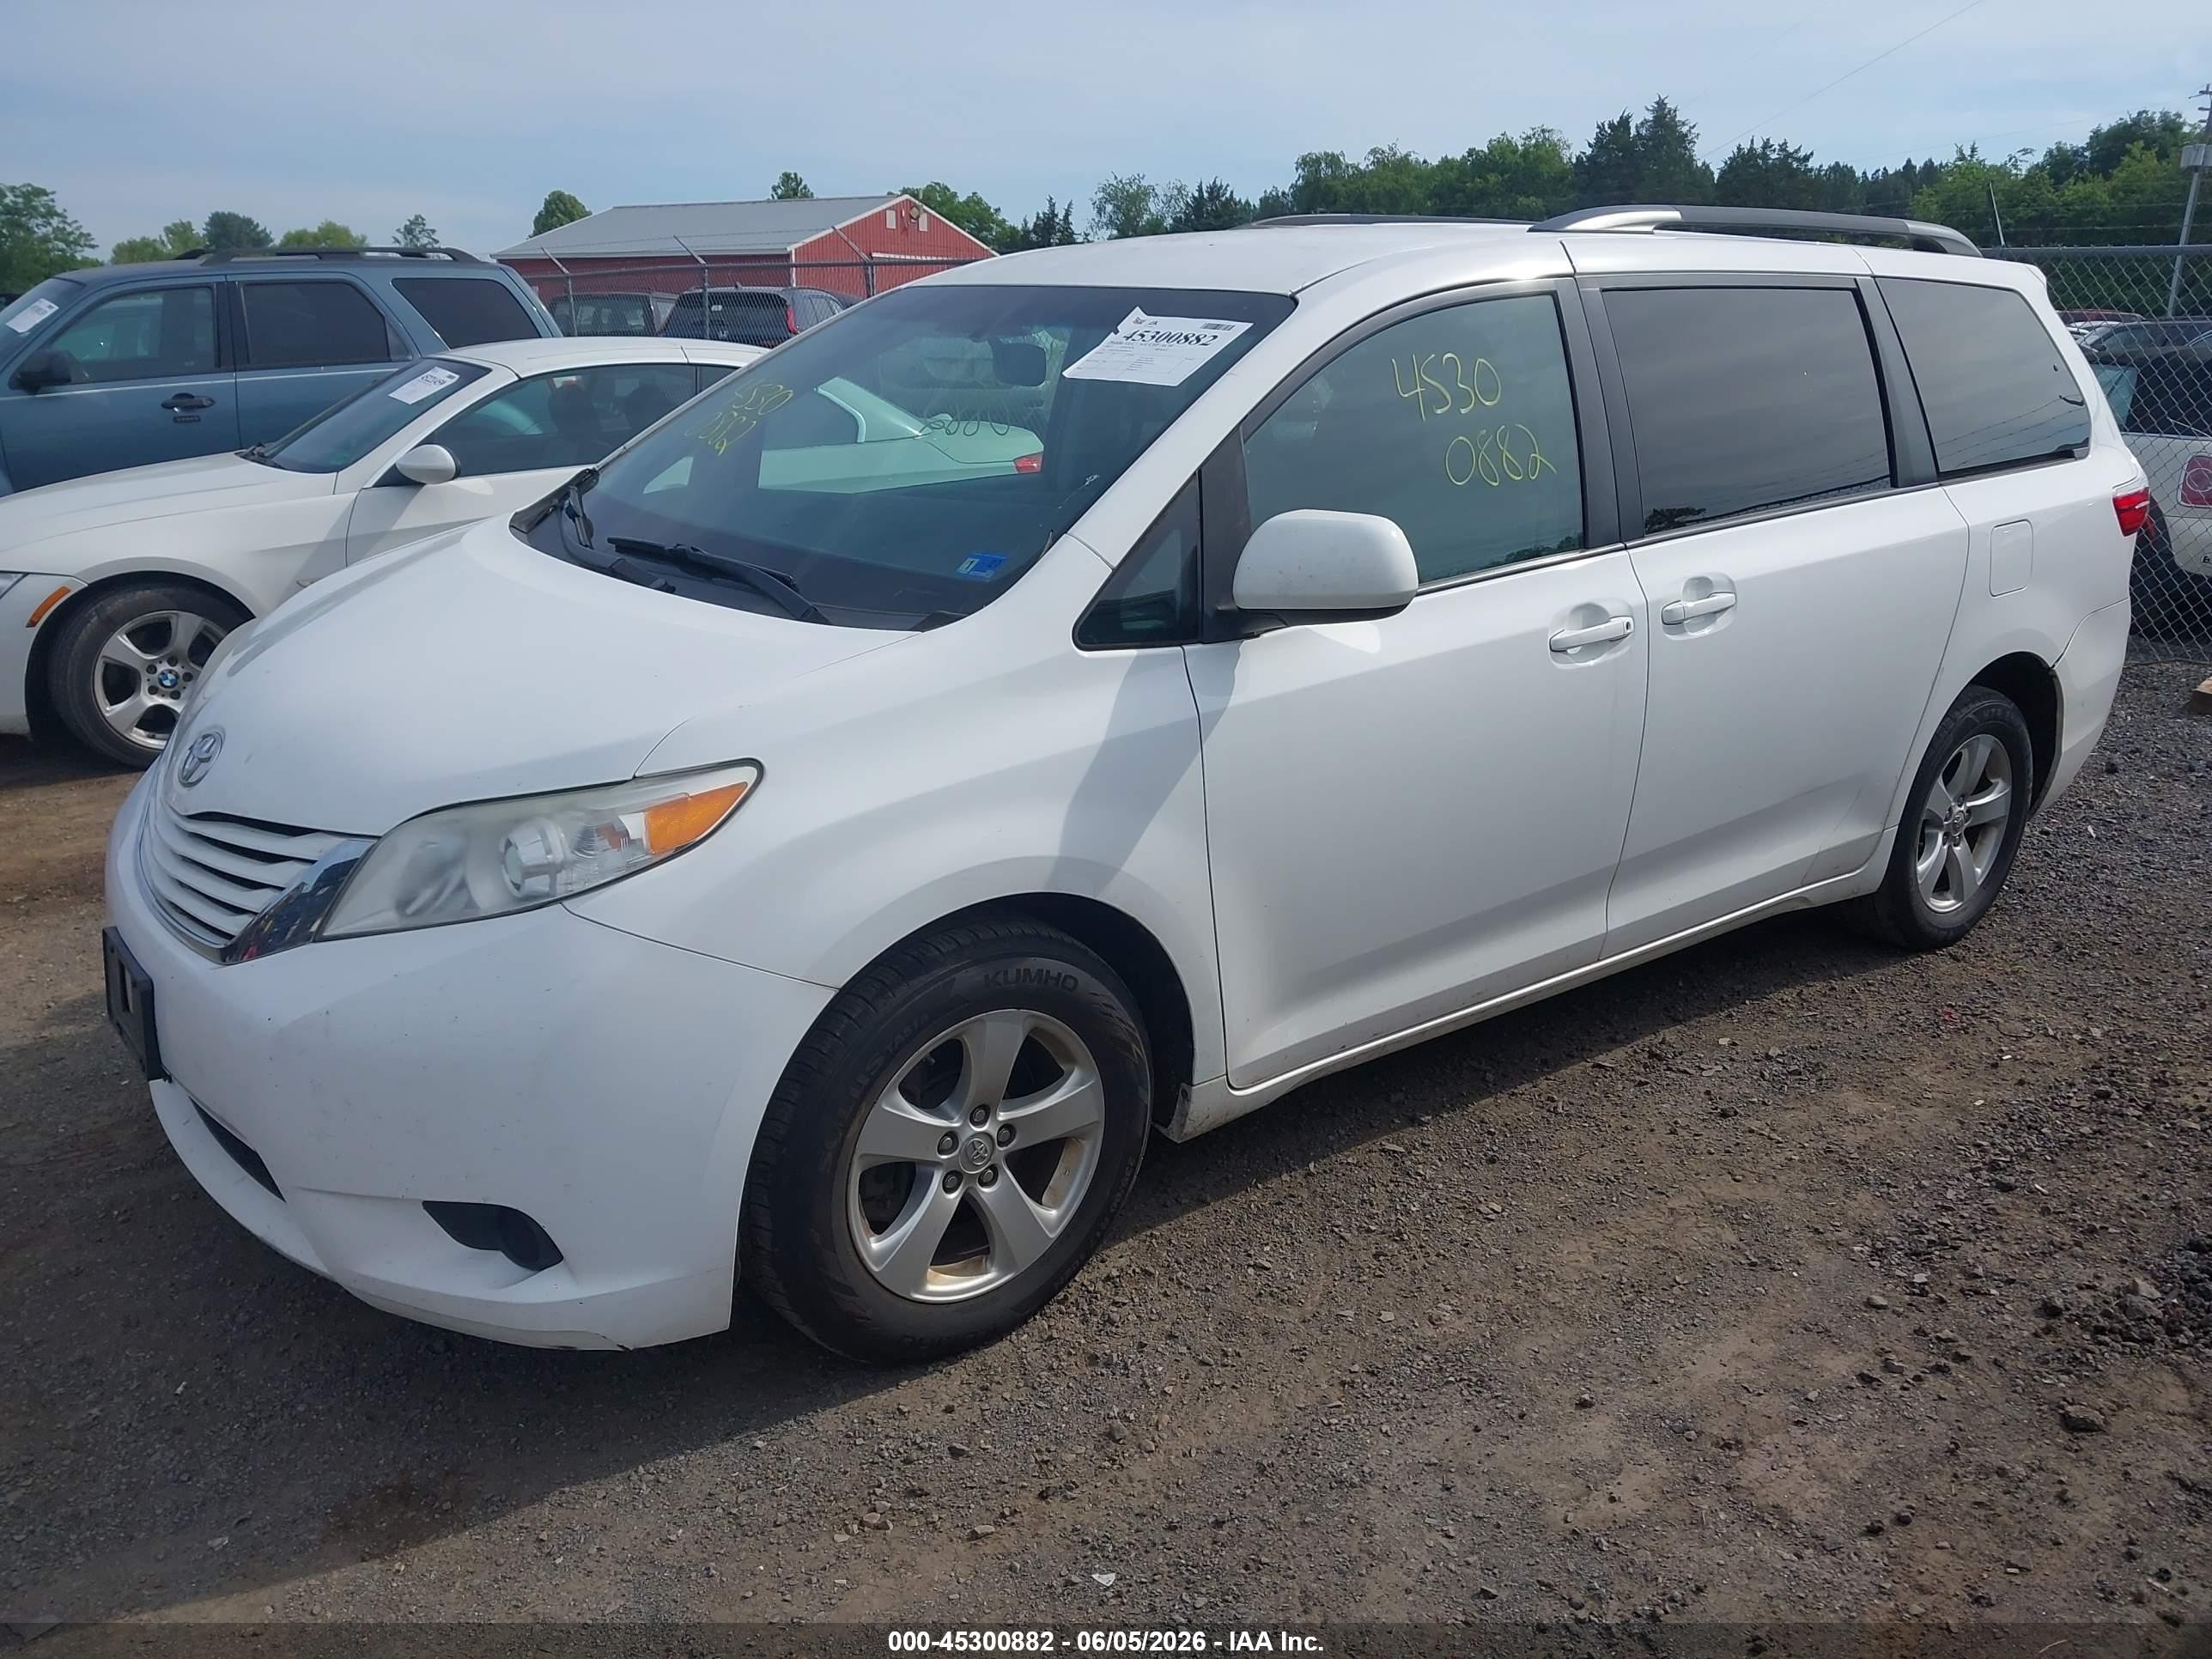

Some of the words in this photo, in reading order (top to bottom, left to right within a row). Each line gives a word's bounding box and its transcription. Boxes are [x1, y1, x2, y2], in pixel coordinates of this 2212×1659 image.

[1122, 329, 1218, 346] 45300882
[1391, 352, 1502, 422] 4530
[1445, 423, 1558, 487] 0882
[983, 967, 1079, 991] KUMHO
